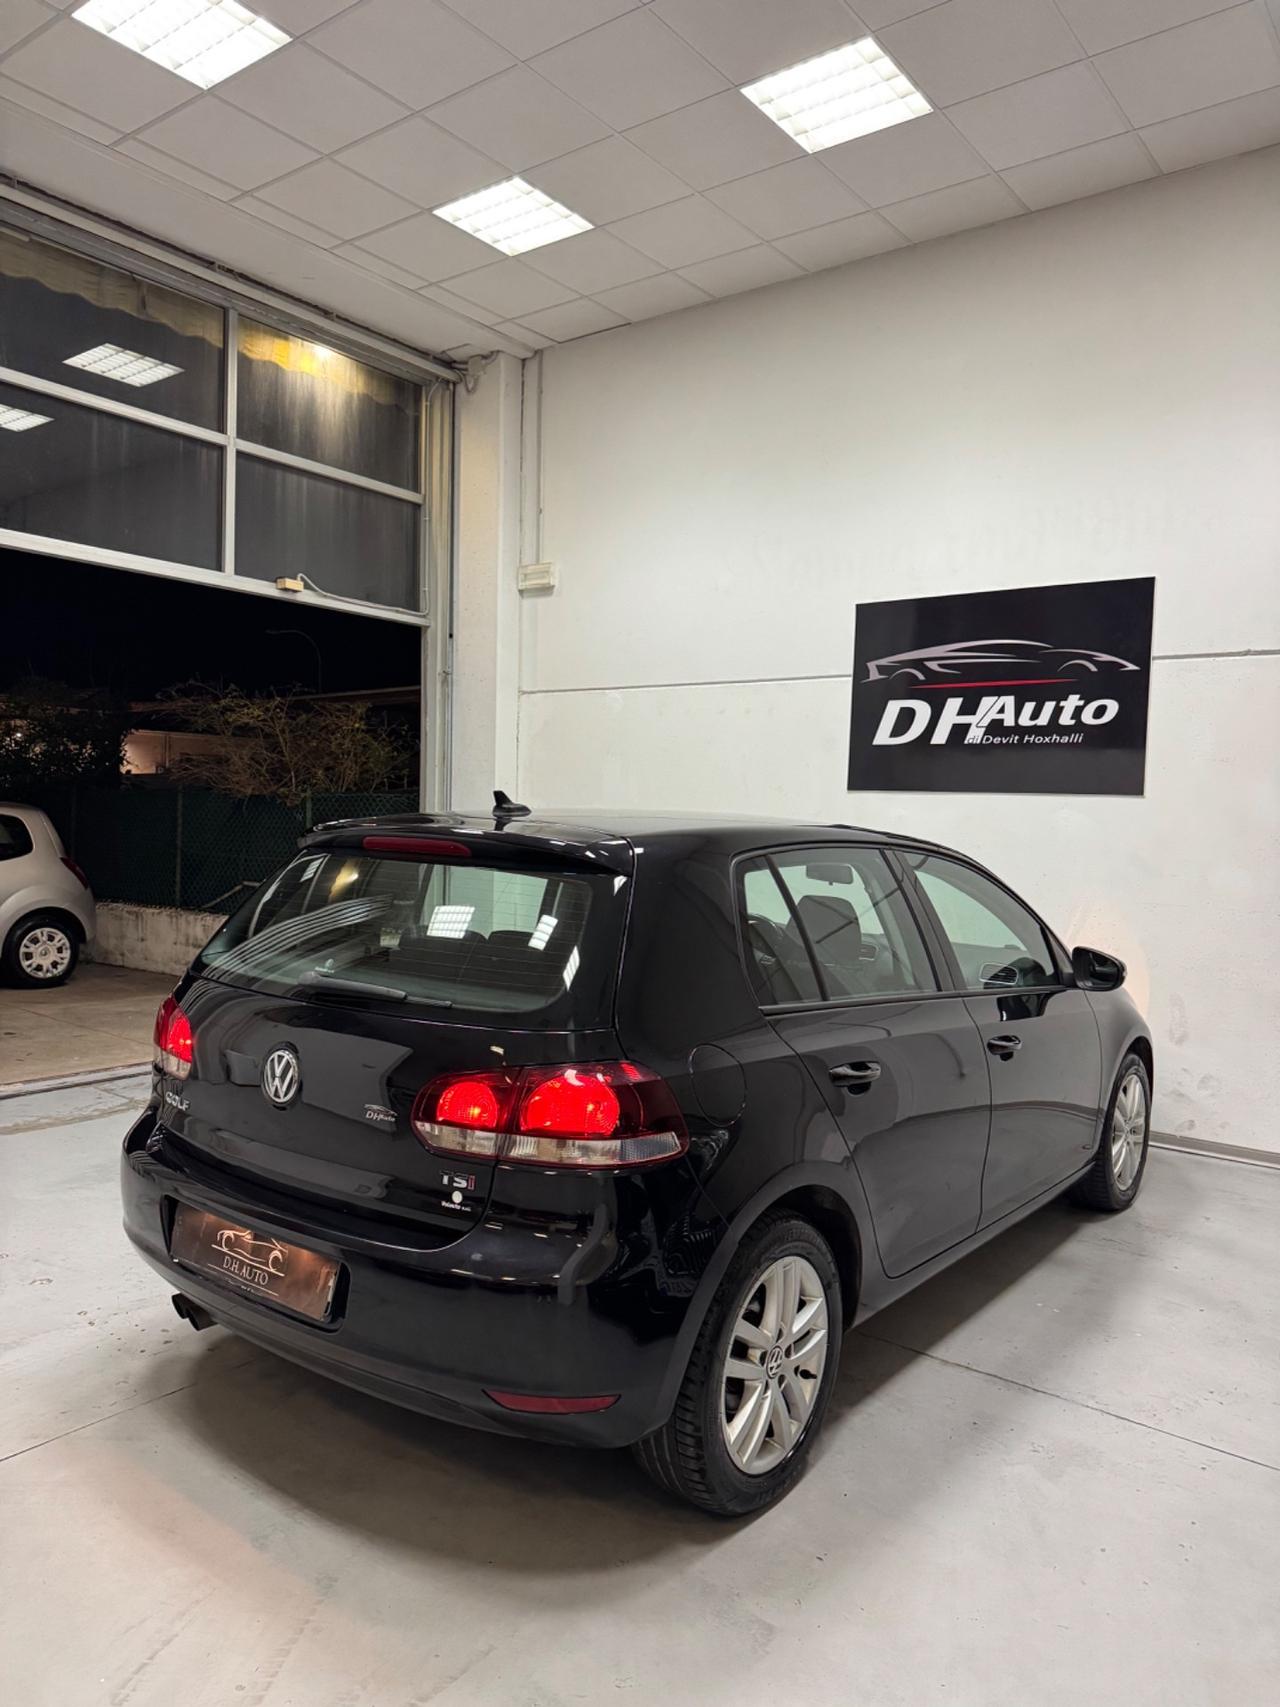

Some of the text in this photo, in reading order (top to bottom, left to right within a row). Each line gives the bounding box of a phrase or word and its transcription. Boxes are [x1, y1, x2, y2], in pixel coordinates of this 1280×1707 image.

[982, 733, 1020, 745] Devit
[1023, 732, 1083, 745] Hoxhalli
[240, 1264, 269, 1286] AUTO
